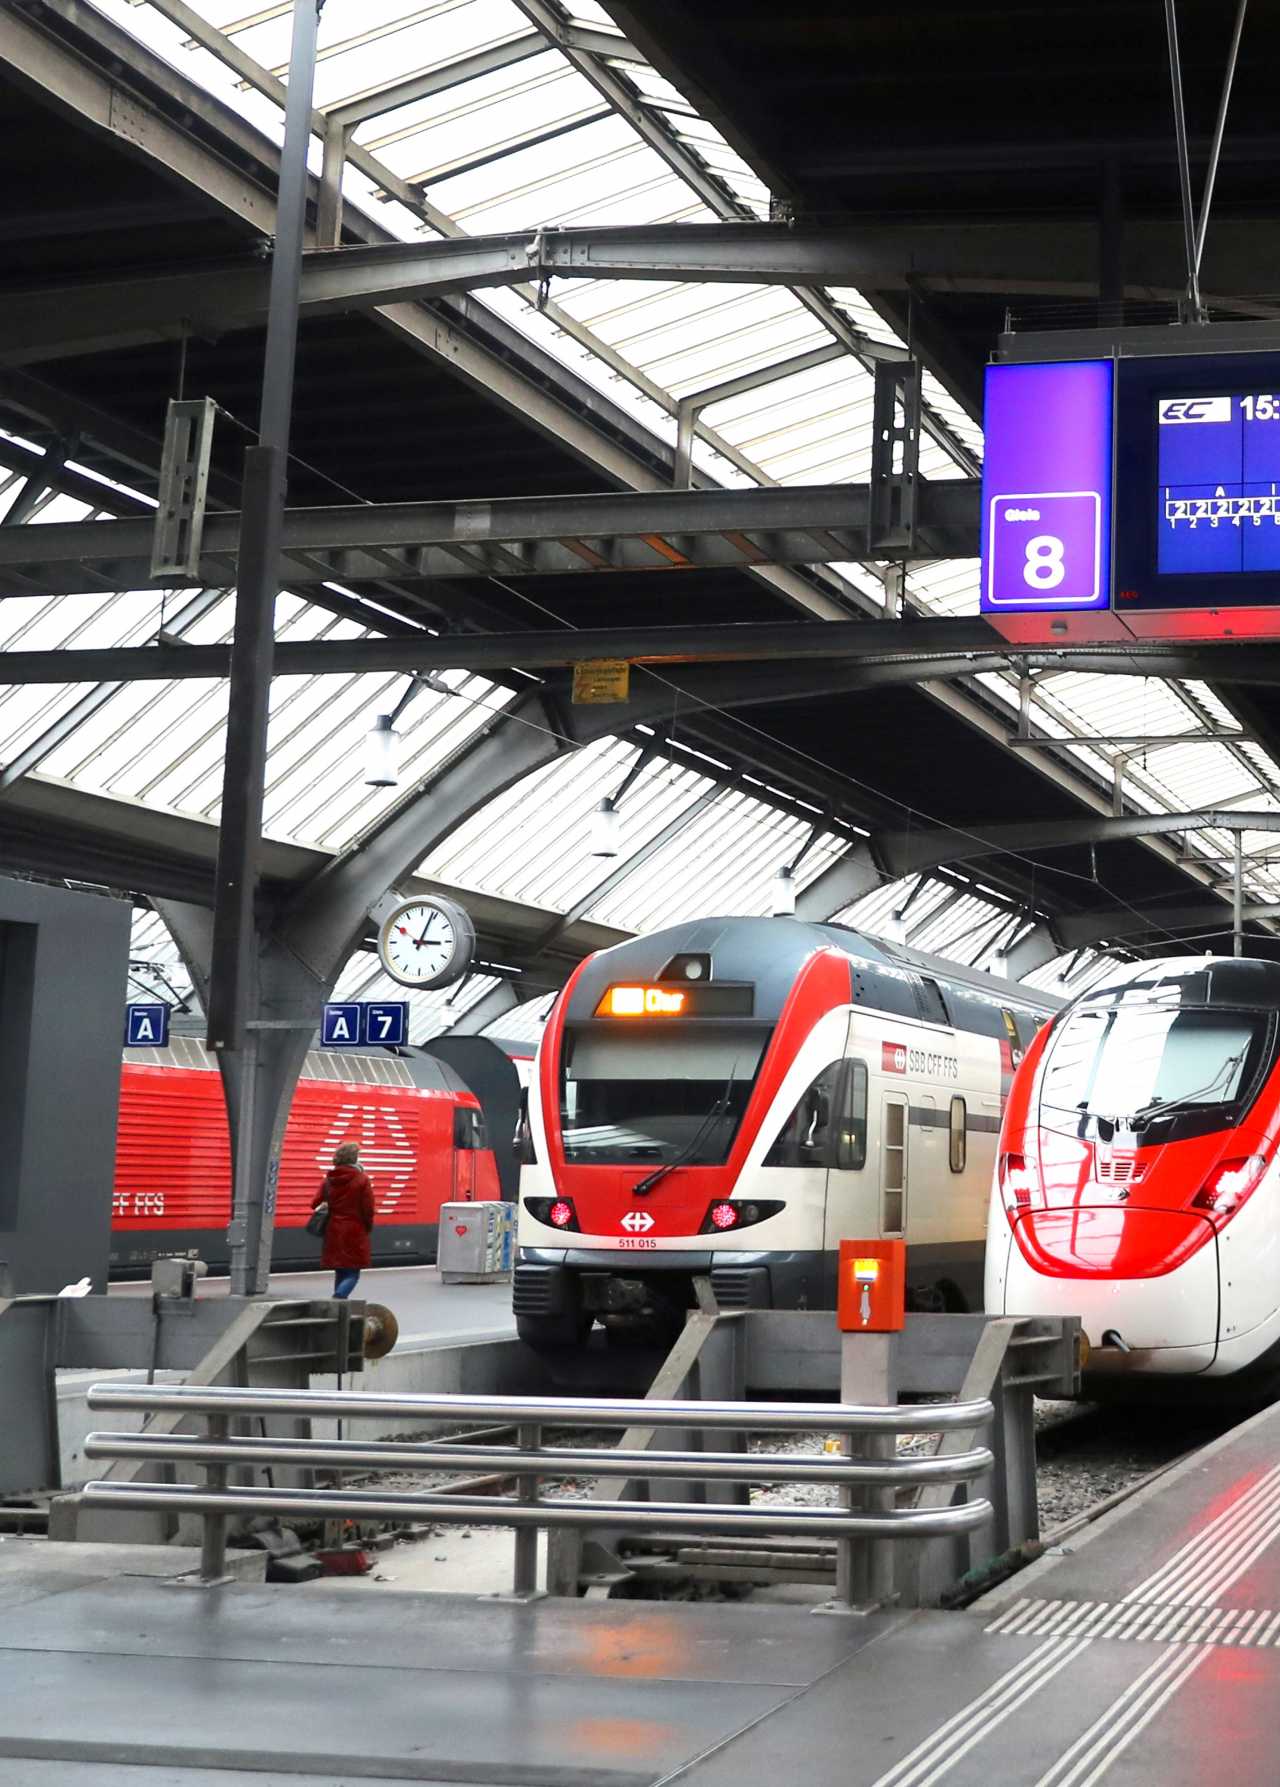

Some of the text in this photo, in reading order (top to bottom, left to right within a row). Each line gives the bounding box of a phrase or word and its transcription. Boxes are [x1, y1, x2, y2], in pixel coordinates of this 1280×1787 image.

[1162, 401, 1213, 420] EC
[1215, 486, 1226, 497] A
[1175, 502, 1188, 517] 2
[1196, 501, 1209, 516] 2
[1217, 500, 1230, 515] 2
[1239, 499, 1252, 514] 2
[1260, 499, 1273, 514] 2
[1023, 535, 1065, 589] 8
[137, 1018, 154, 1040] A
[332, 1017, 350, 1039] A
[377, 1016, 393, 1039] 7
[908, 1049, 925, 1073] SBB
[943, 1056, 959, 1080] FFS
[134, 1192, 165, 1216] FFS
[618, 1239, 657, 1248] 511 015
